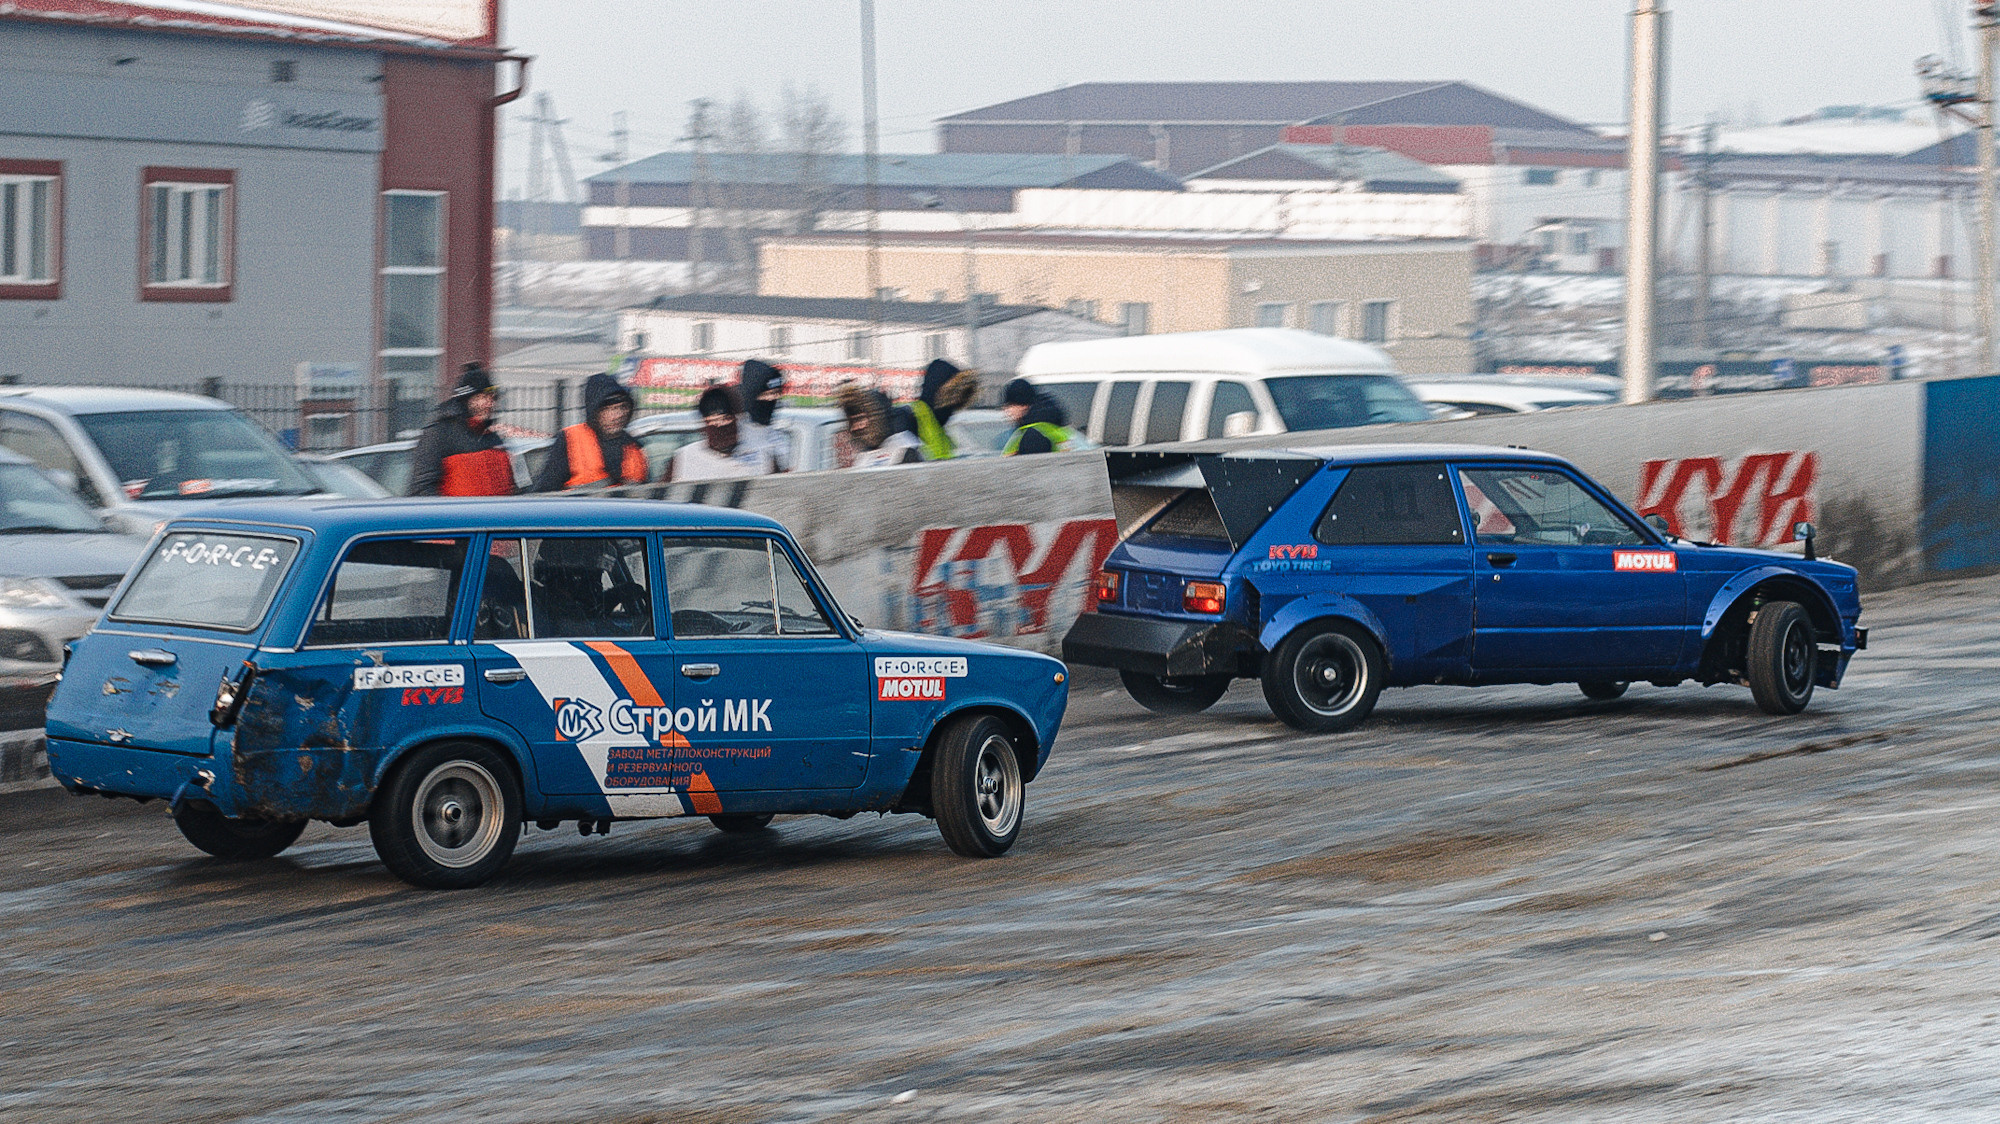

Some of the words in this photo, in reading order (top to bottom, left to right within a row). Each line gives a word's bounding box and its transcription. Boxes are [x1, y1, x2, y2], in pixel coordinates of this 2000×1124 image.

[1268, 544, 1318, 560] KYB
[1252, 560, 1291, 572] TOYO
[1292, 560, 1332, 571] TIRES
[1617, 554, 1674, 570] MOTUL
[401, 687, 465, 706] KYB
[881, 679, 944, 698] MOTUL
[608, 748, 644, 761] ЗАВОД
[646, 745, 772, 760] МЕТАЛЛОКОНСТРУКЦИЙ
[606, 762, 615, 773] И
